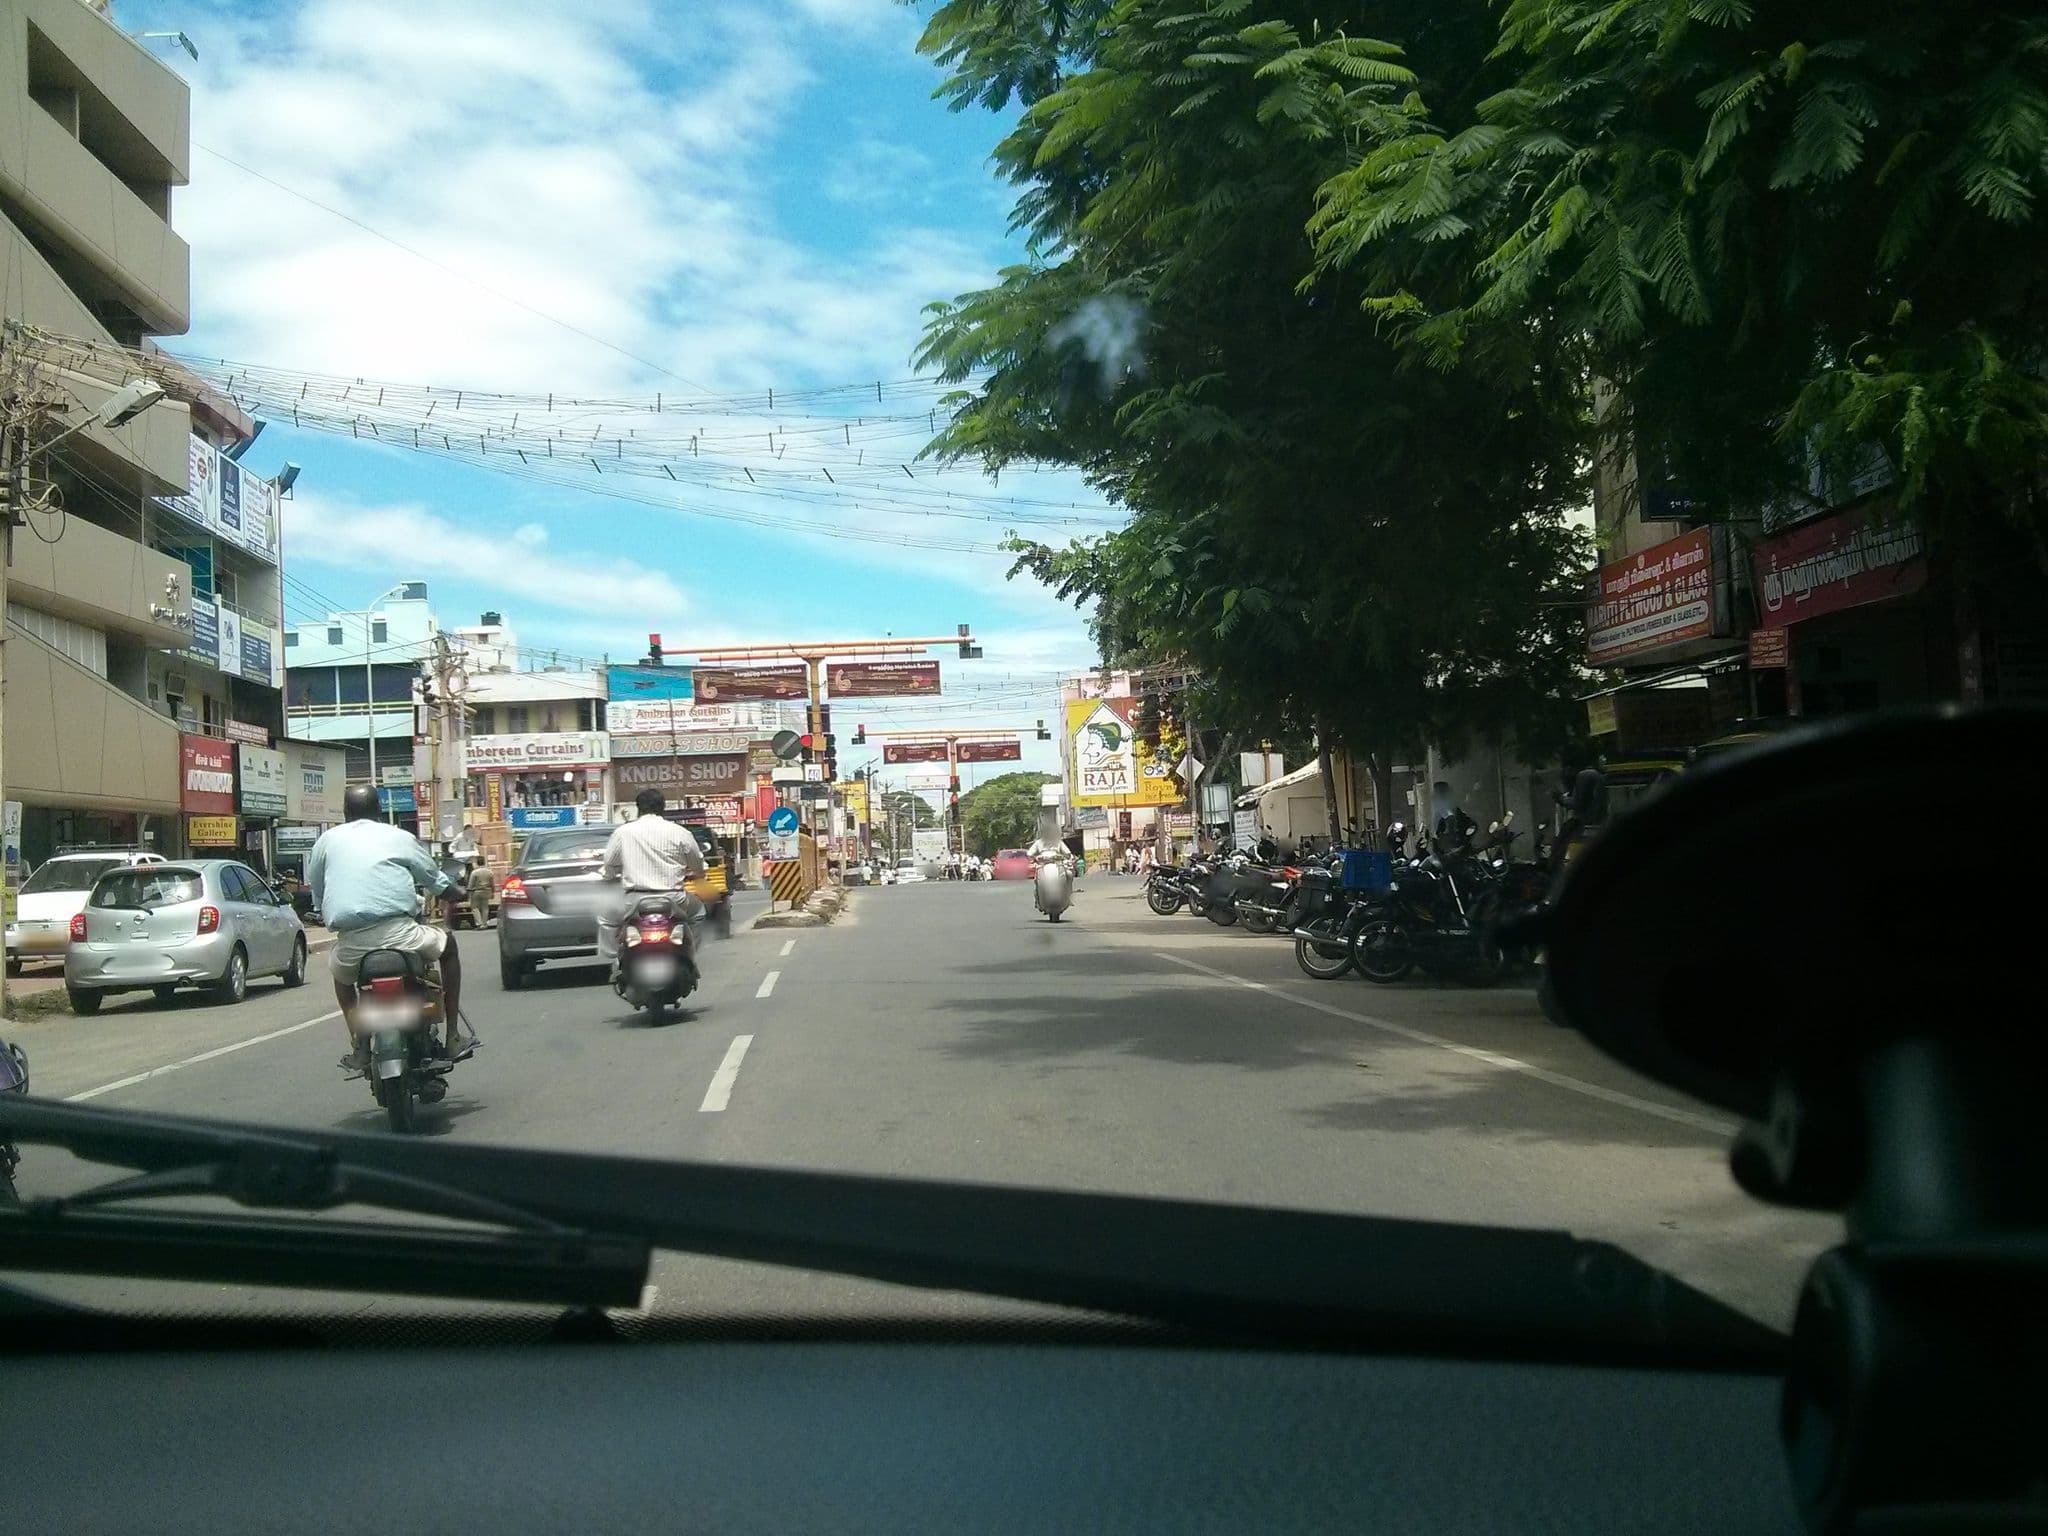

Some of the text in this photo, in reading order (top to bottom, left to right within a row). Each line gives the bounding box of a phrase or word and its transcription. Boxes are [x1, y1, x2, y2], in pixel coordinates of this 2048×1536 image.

[1619, 584, 1662, 622] PLYWOOD
[1665, 581, 1673, 606] &
[1674, 569, 1708, 604] GLASS
[466, 741, 584, 758] mbereen Curtains
[693, 735, 750, 751] SHOP
[619, 761, 740, 783] KNOBS SHOP
[1084, 771, 1127, 788] RAJA
[304, 784, 324, 794] FOAM
[193, 820, 233, 828] Evershine
[197, 829, 227, 838] Gallery
